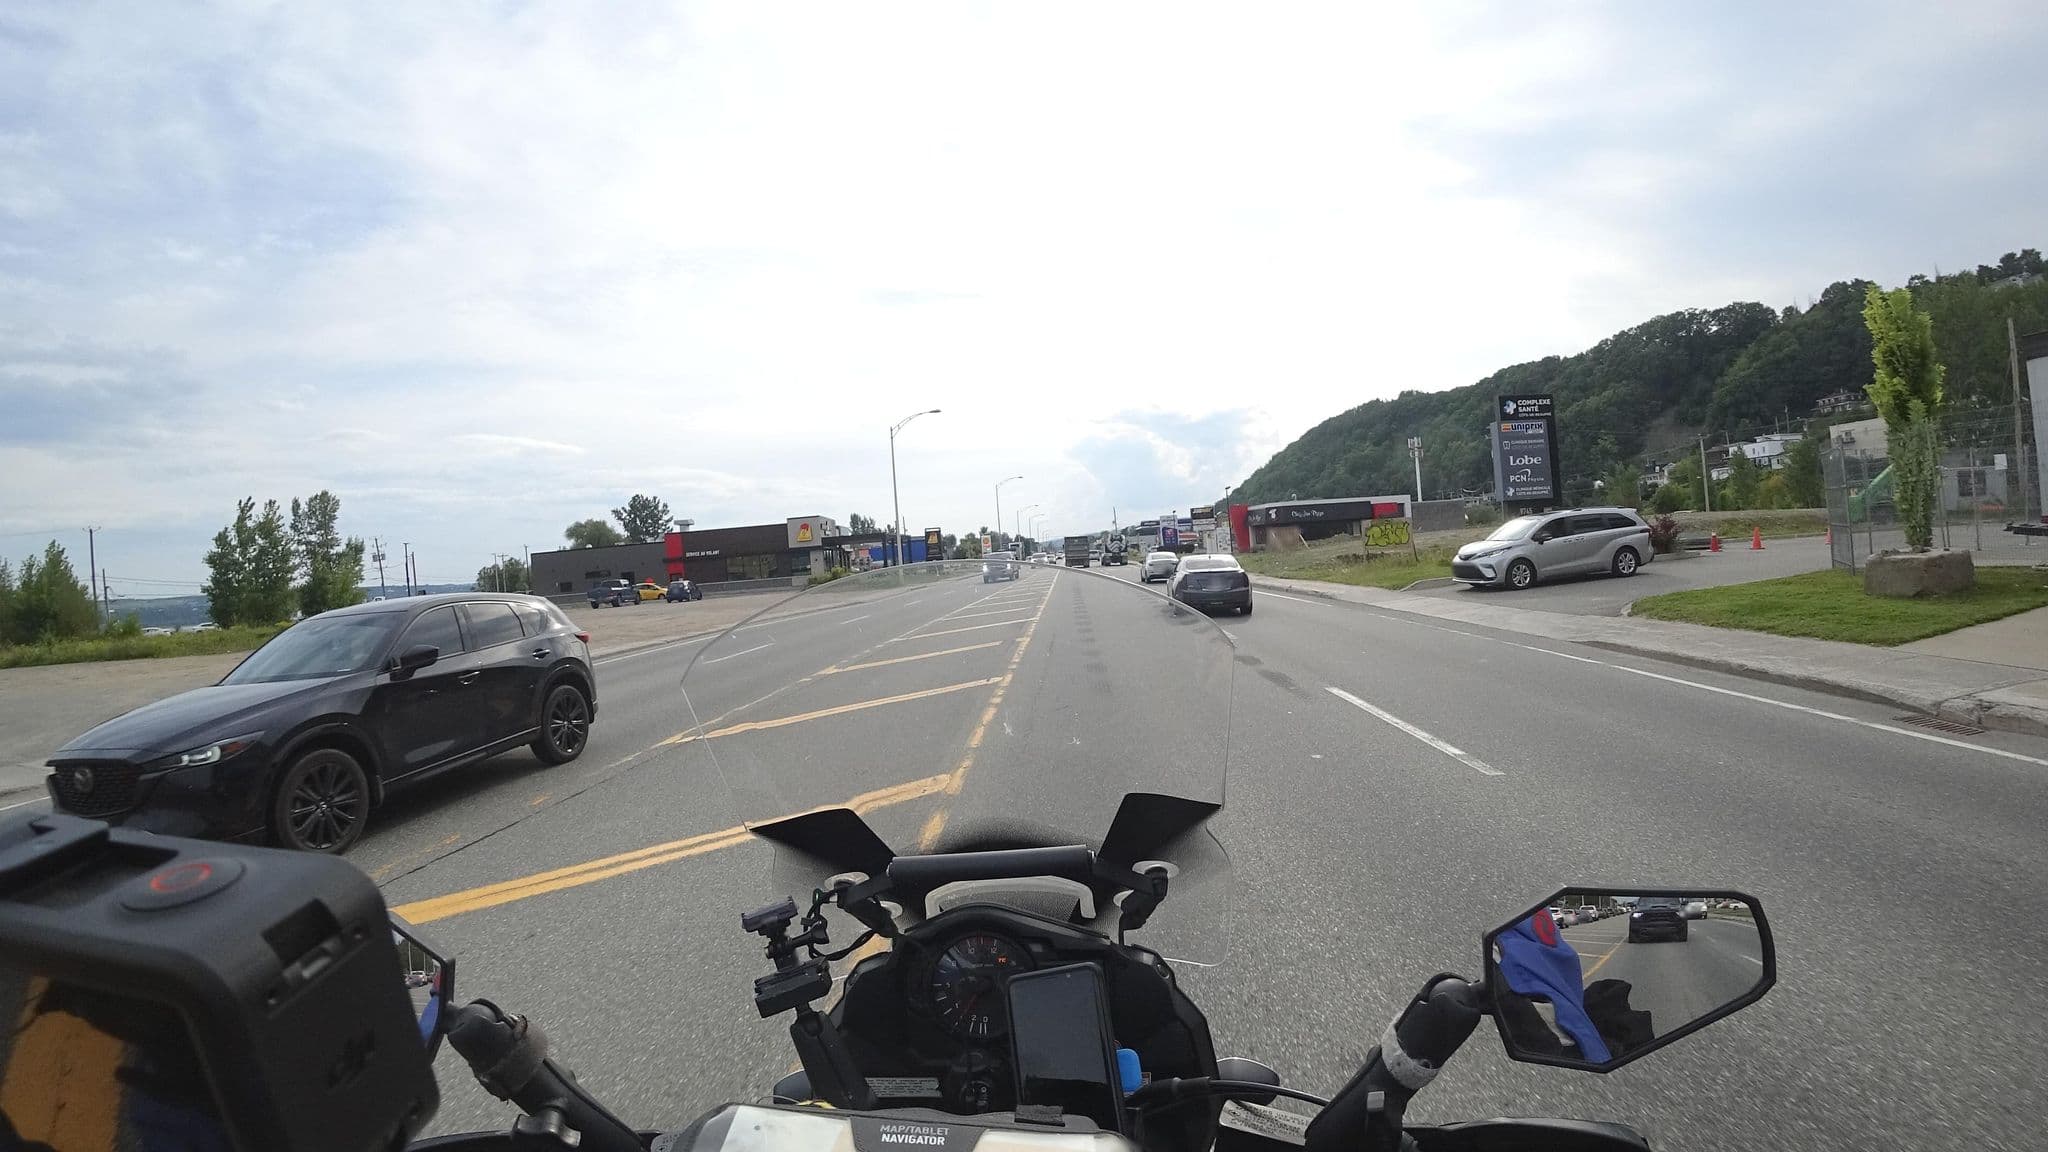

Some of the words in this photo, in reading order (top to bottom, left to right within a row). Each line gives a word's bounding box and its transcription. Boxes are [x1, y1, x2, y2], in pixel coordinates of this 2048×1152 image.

[1511, 422, 1544, 432] uniprix
[1509, 455, 1542, 465] Lobe
[1509, 474, 1527, 482] PCN
[880, 1124, 950, 1136] MAP/TABLET
[881, 1133, 946, 1146] NAVIGATOR
